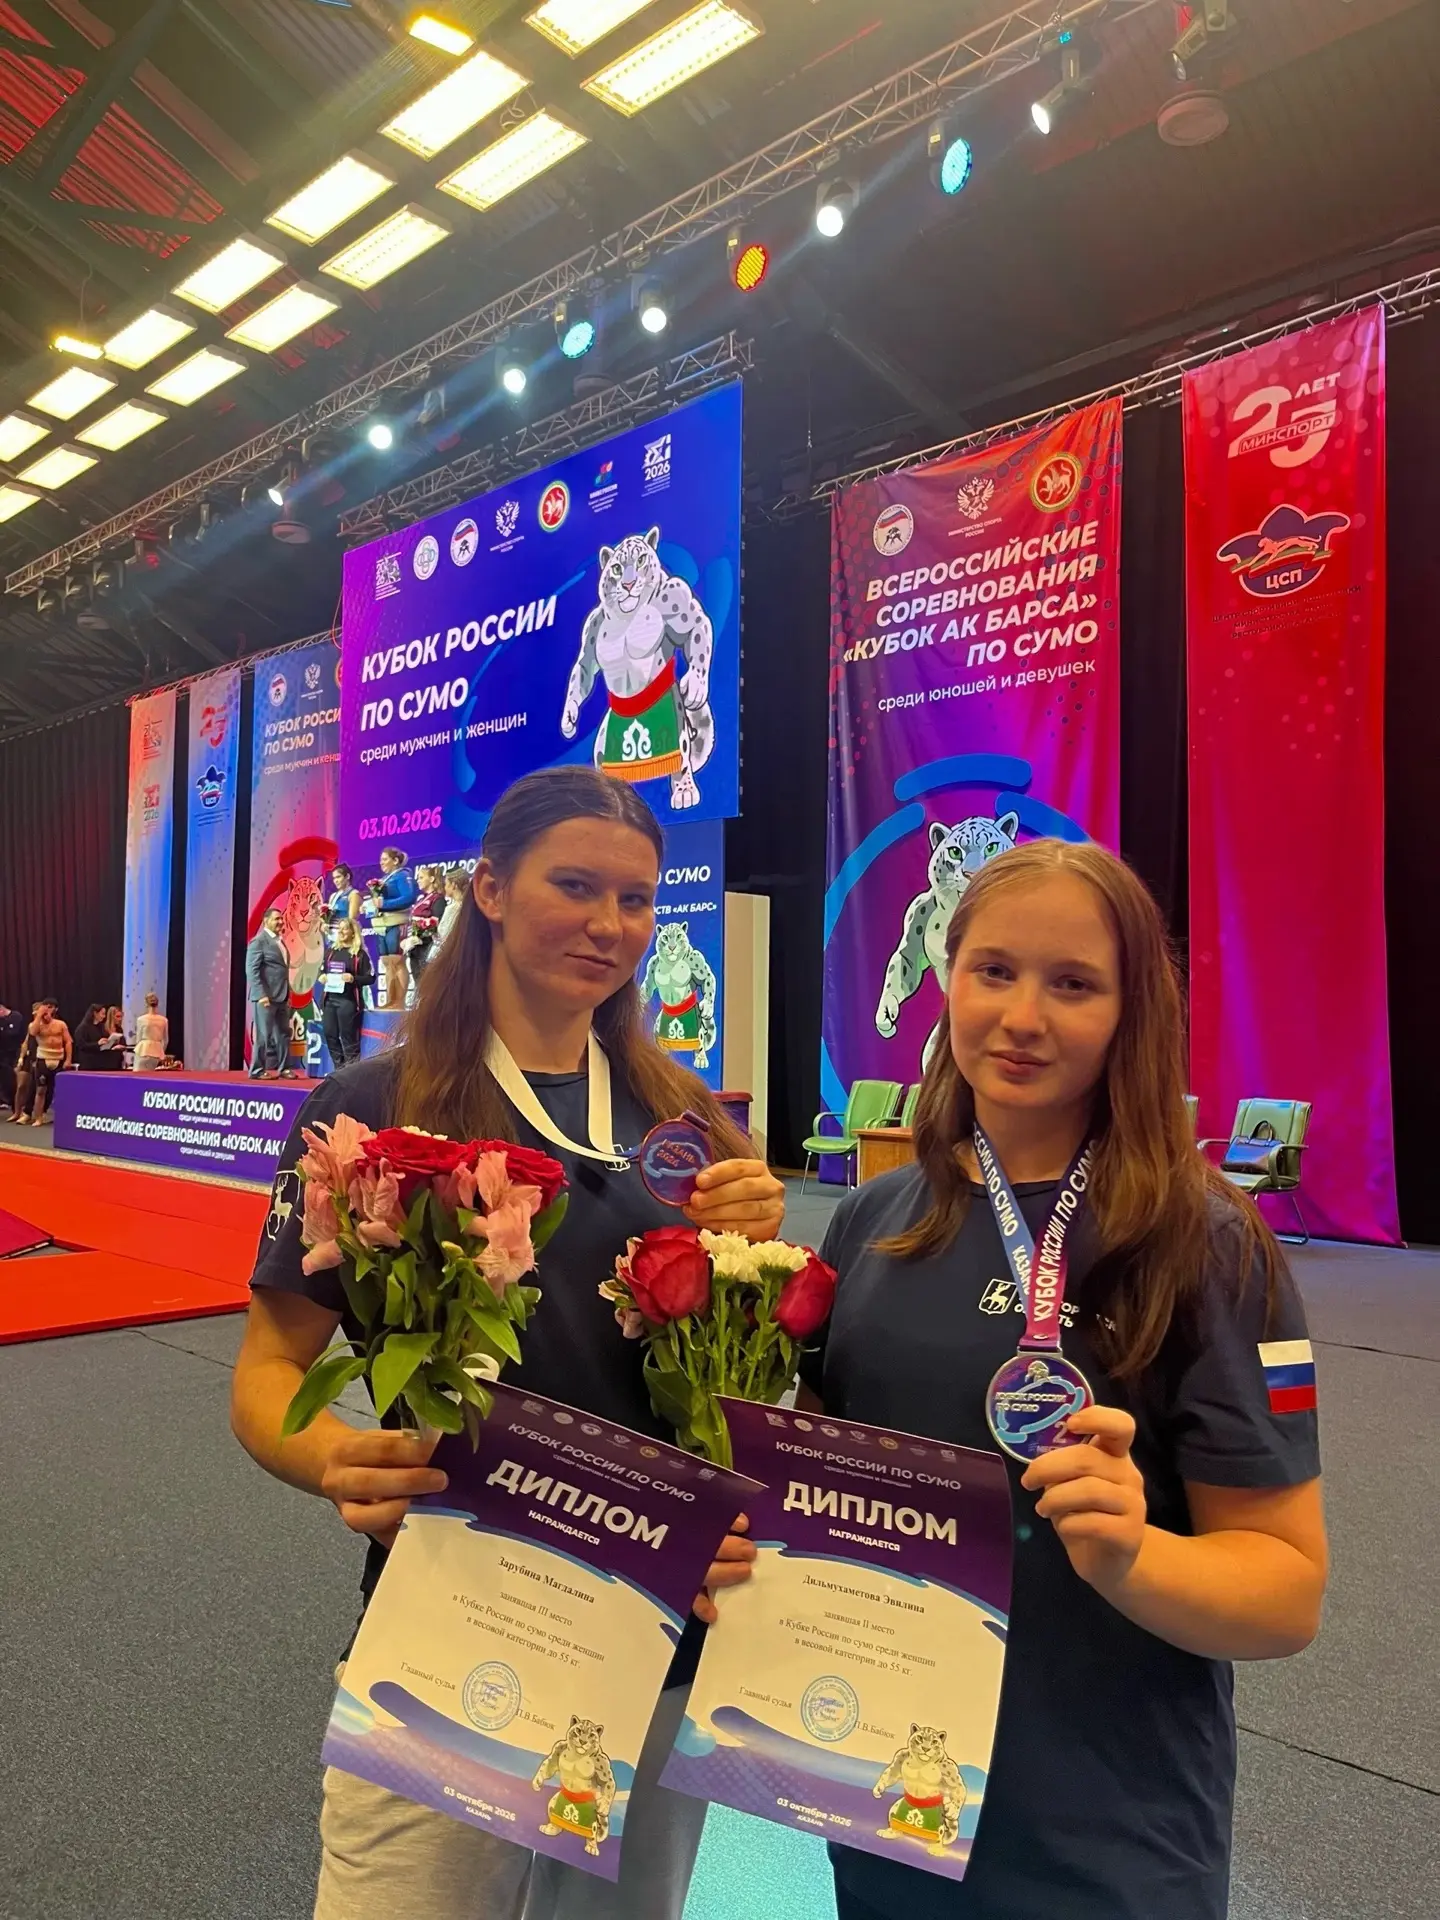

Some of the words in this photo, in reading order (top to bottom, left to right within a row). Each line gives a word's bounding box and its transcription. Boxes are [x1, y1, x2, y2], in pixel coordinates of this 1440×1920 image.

[1294, 372, 1341, 399] ЛЕТ
[1241, 414, 1333, 453] МИНСПОРТ
[644, 465, 671, 481] 2026
[866, 521, 1099, 602] ВСЕРОССИЙСКИЕ
[1266, 569, 1303, 590] ЦСП
[876, 553, 1098, 627] СОРЕВНОВАНИЯ
[361, 630, 439, 684] КУБОК
[443, 595, 558, 657] РОССИИ
[842, 624, 937, 663] «КУБОК
[940, 616, 978, 643] АК
[984, 591, 1098, 633] БАРСА»
[966, 643, 1007, 668] ПО
[1013, 620, 1099, 657] СУМО
[877, 692, 925, 713] среди
[928, 676, 997, 702] юношей
[1000, 675, 1012, 688] и
[1015, 658, 1096, 689] девушек
[265, 716, 301, 738] КУБОК
[303, 707, 341, 729] РОССИ
[360, 698, 393, 732] ПО
[398, 677, 469, 721] СУМО
[264, 740, 280, 756] ПО
[282, 732, 314, 752] СУМО
[360, 738, 398, 765] среди
[400, 730, 451, 757] мужчин
[453, 727, 464, 742] и
[465, 712, 528, 740] женщин
[359, 805, 443, 840] 03.10.2026
[665, 865, 711, 885] СУМО
[689, 902, 717, 912] БАРС»
[307, 1032, 322, 1065] 2
[143, 1091, 177, 1111] КУБОК
[179, 1095, 225, 1115] РОССИИ
[226, 1099, 245, 1117] ПО
[246, 1101, 284, 1122] СУМО
[75, 1114, 144, 1137] ВСЕРОССИЙСКИЕ
[145, 1123, 220, 1148] СОРЕВНОВАНИЯ
[221, 1134, 263, 1153] «КУБОК
[263, 1139, 281, 1156] АК
[974, 1124, 994, 1172] ССИИ
[986, 1166, 1001, 1193] ПО
[994, 1190, 1019, 1237] СУМО
[1055, 1190, 1078, 1221] ПО
[1039, 1215, 1067, 1267] РОССИИ
[1033, 1264, 1061, 1322] КУБОК
[1052, 1420, 1068, 1444] 2
[508, 1423, 558, 1450] КУБОК
[561, 1443, 628, 1475] РОССИИ
[626, 1470, 650, 1485] ПО
[651, 1480, 696, 1502] СУМО
[775, 1441, 823, 1460] КУБОК
[826, 1452, 887, 1474] РОССИИ
[890, 1467, 913, 1480] ПО
[916, 1472, 962, 1490] СУМО
[486, 1459, 669, 1550] ДИПЛОМ
[783, 1480, 957, 1546] ДИПЛОМ
[528, 1510, 600, 1546] НАГРАЖДАЕТСЯ
[828, 1528, 900, 1552] НАГРАЖДАЕТСЯ
[497, 1556, 541, 1582] Зарубина
[543, 1575, 595, 1604] Магдалина
[802, 1574, 881, 1603] Дильмухаметова
[882, 1594, 925, 1614] Эвилина
[499, 1591, 537, 1612] занявшая
[537, 1605, 549, 1617] III
[549, 1612, 573, 1627] место
[823, 1610, 861, 1626] занявшая
[862, 1619, 870, 1628] II
[871, 1623, 895, 1636] место
[459, 1594, 484, 1613] Кубке
[485, 1605, 513, 1625] России
[515, 1619, 526, 1630] по
[526, 1624, 547, 1638] сумо
[547, 1633, 571, 1649] среди
[572, 1643, 605, 1662] женщин
[466, 1615, 472, 1623] в
[473, 1620, 505, 1637] весовой
[506, 1632, 546, 1655] категории
[547, 1649, 558, 1659] до
[558, 1652, 570, 1663] 55
[778, 1618, 784, 1626] в
[785, 1618, 810, 1633] Кубке
[811, 1625, 840, 1641] России
[841, 1635, 852, 1644] по
[853, 1638, 874, 1651] сумо
[875, 1645, 899, 1658] среди
[900, 1651, 936, 1668] женщин
[801, 1638, 833, 1654] весовой
[834, 1648, 876, 1666] категории
[877, 1660, 888, 1669] до
[889, 1662, 900, 1672] 55
[400, 1661, 434, 1682] Главный
[434, 1676, 456, 1692] судья
[739, 1686, 771, 1702] Главный
[771, 1697, 793, 1709] судья
[443, 1785, 455, 1797] 03
[456, 1792, 493, 1813] октября
[494, 1806, 517, 1821] 2026
[465, 1806, 492, 1821] КАЗАНЬ
[776, 1797, 789, 1807] 03
[789, 1802, 828, 1819] октября
[828, 1813, 853, 1827] 2026
